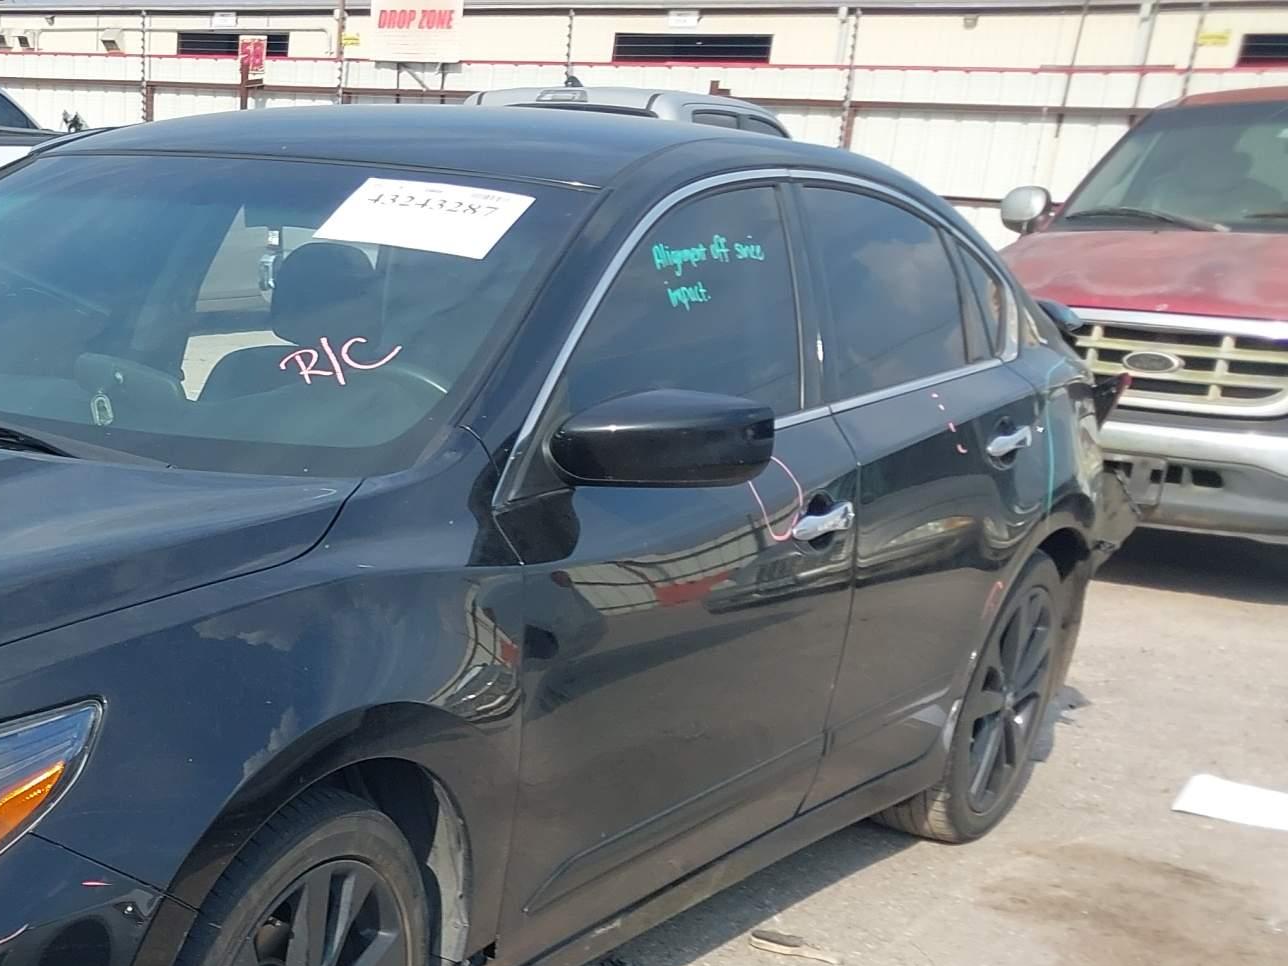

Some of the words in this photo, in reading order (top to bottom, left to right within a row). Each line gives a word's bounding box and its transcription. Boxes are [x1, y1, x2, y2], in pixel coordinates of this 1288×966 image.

[377, 9, 417, 29] DROP
[417, 9, 455, 29] ZONE
[367, 193, 499, 217] 43243287
[709, 234, 730, 262] off
[278, 336, 402, 385] R/C
